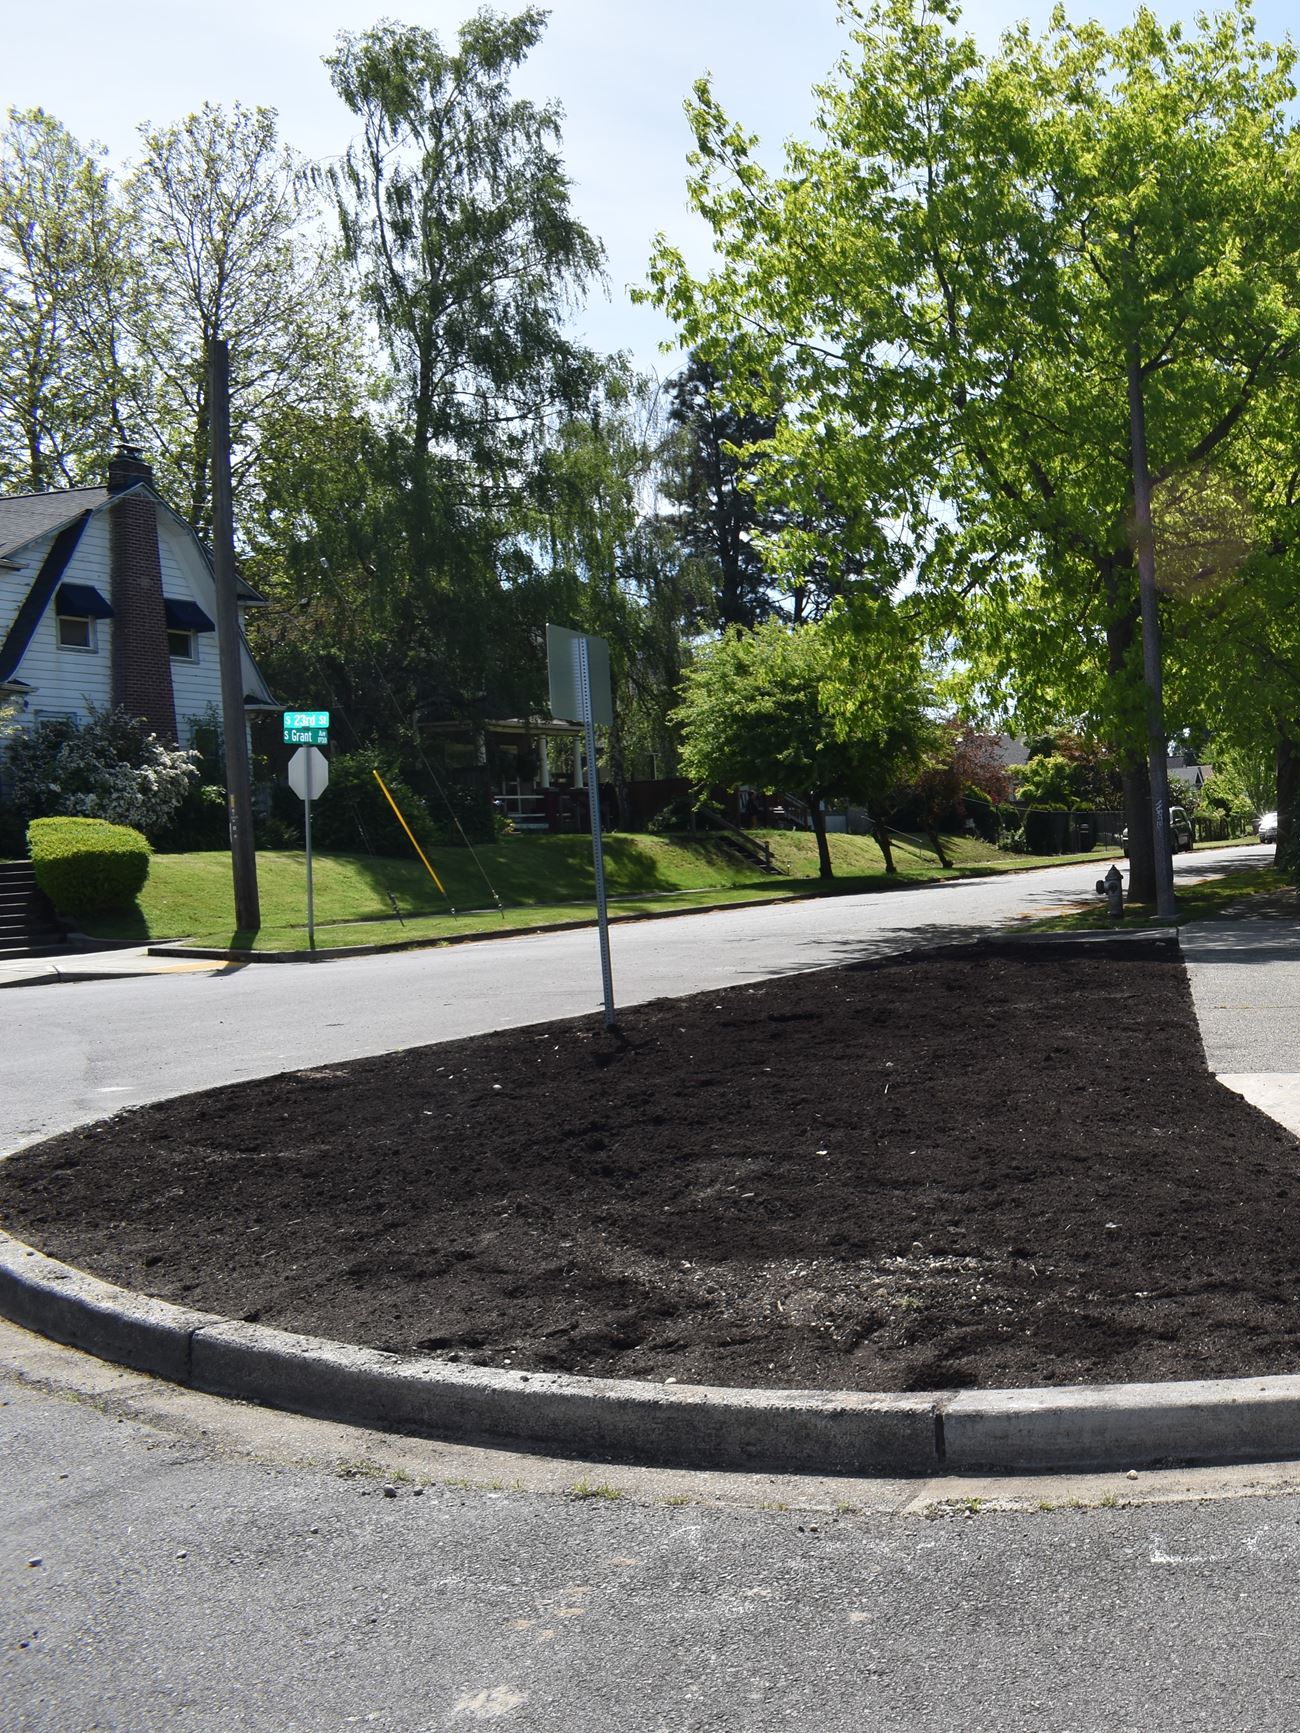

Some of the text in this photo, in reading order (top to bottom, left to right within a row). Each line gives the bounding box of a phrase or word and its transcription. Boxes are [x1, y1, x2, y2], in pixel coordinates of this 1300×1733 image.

[285, 715, 291, 725] S
[294, 714, 316, 726] 23rd
[284, 730, 289, 740] S
[291, 729, 312, 742] Grant
